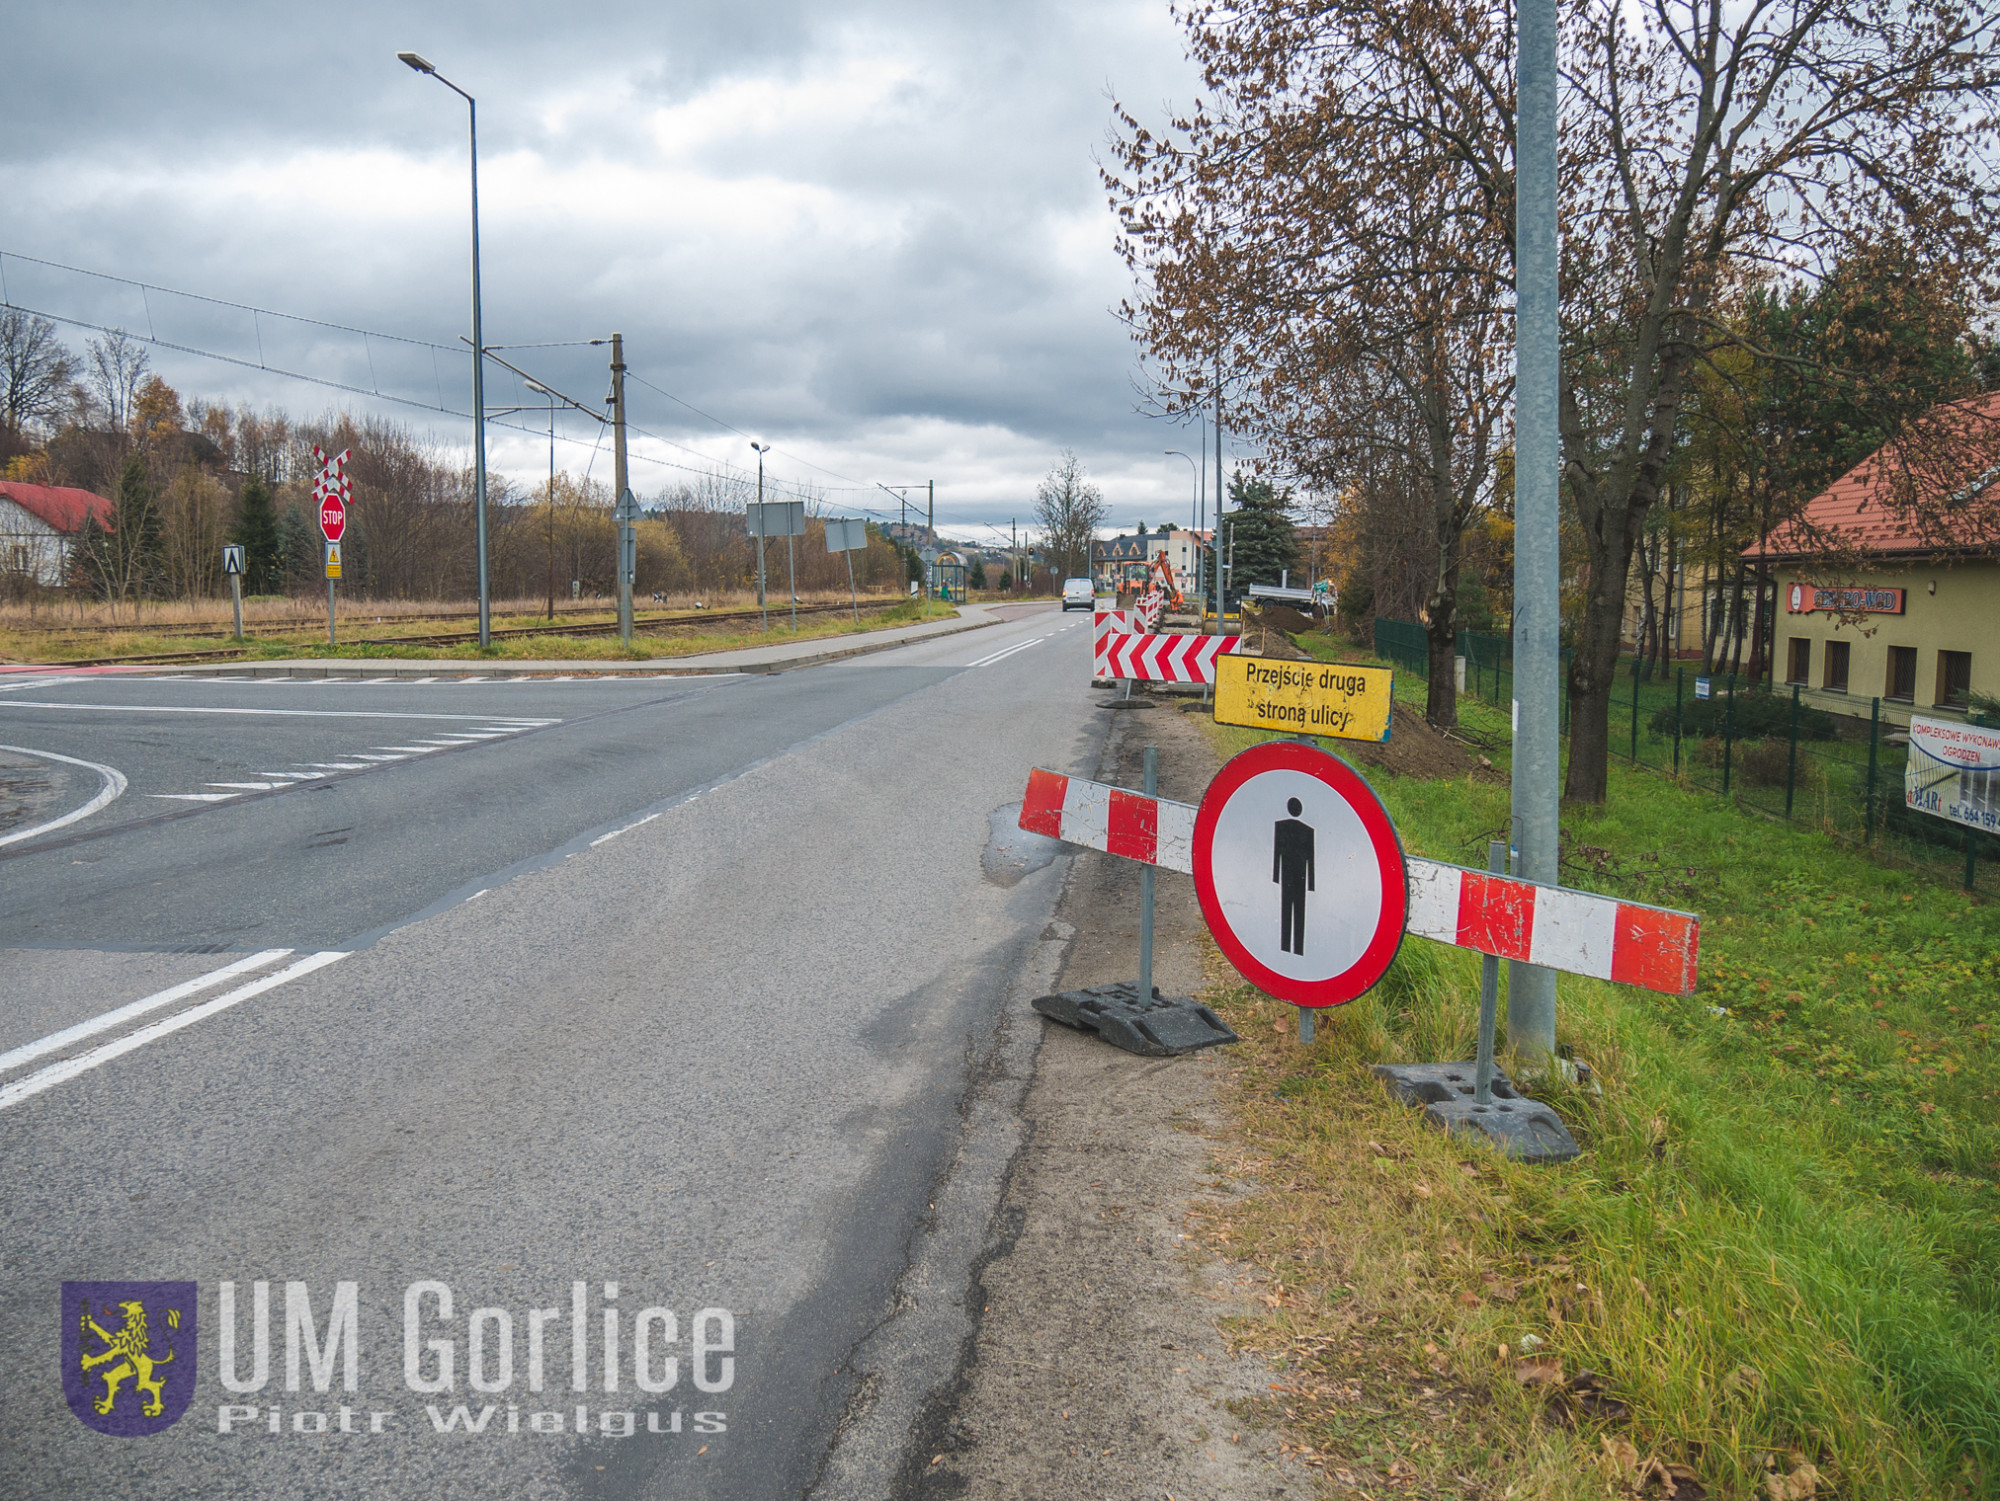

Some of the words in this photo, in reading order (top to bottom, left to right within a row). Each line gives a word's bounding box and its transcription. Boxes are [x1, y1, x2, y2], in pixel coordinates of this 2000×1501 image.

[323, 510, 343, 525] STOP
[1814, 590, 1896, 609] CENRO-WOD
[1246, 662, 1313, 690] Przejście
[1319, 669, 1366, 696] drugą
[1257, 701, 1306, 728] stroną
[1311, 705, 1349, 732] ulicy
[1912, 723, 1962, 742] KOMPLEKSOWE
[1949, 804, 1962, 818] tel.
[1964, 807, 1979, 823] 664
[1981, 811, 1997, 828] 159
